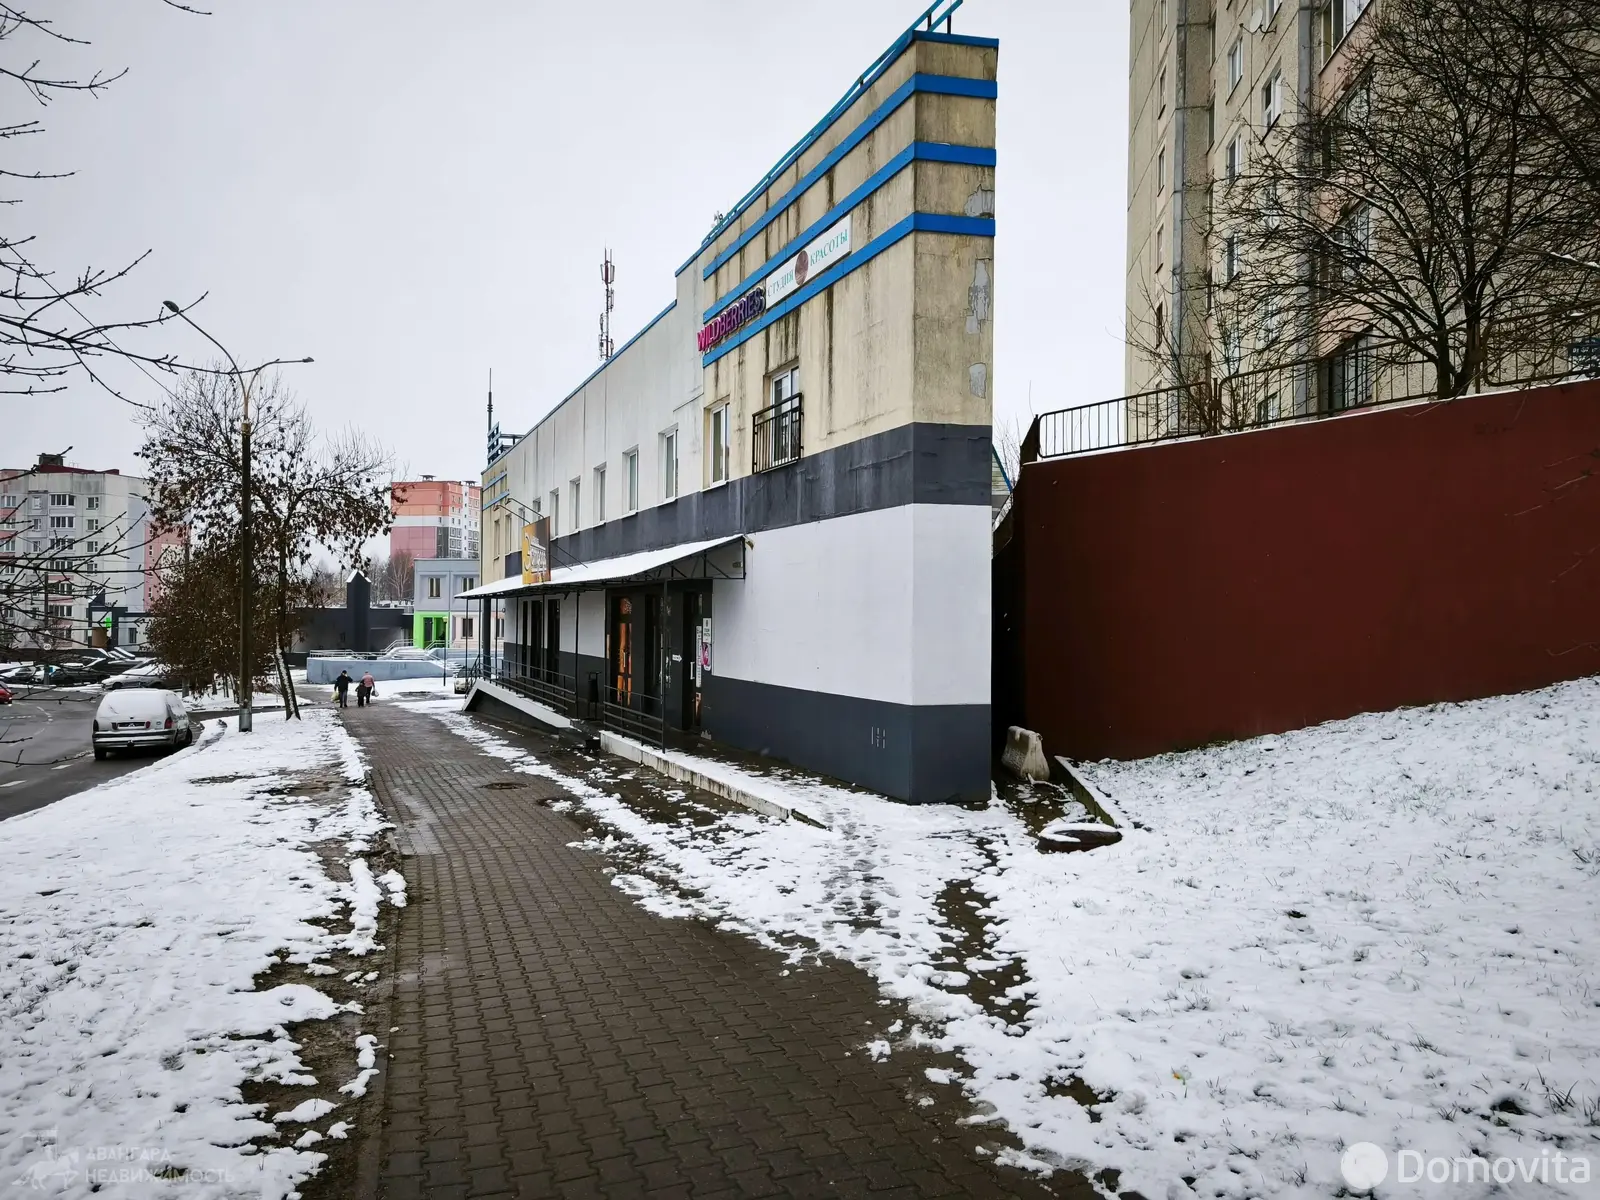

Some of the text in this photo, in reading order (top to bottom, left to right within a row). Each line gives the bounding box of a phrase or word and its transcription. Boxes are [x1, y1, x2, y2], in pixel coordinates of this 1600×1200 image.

[767, 228, 849, 298] СТУДИЯ КРАСОТЫ
[697, 286, 766, 353] WILDBERRIES
